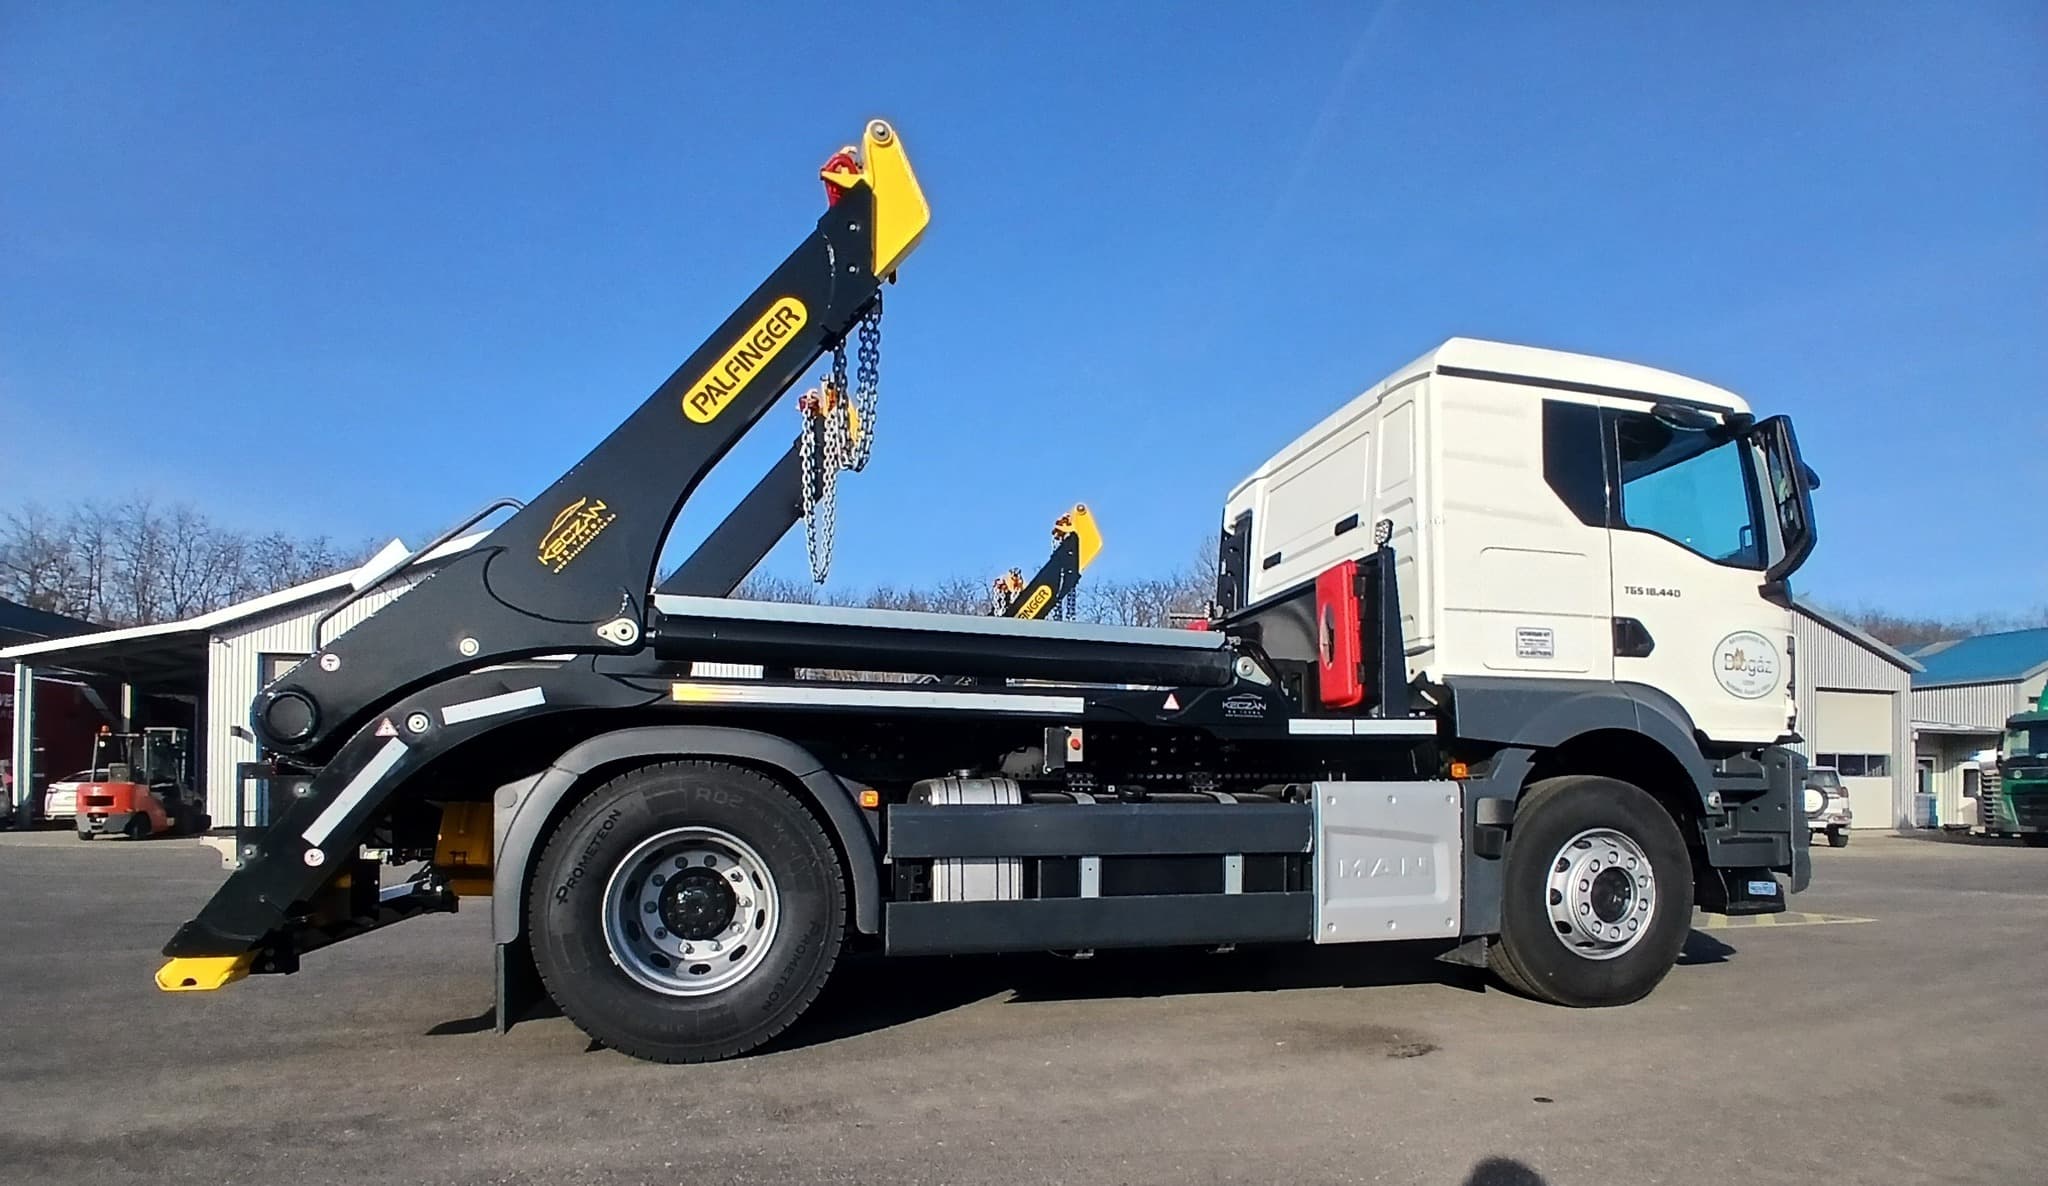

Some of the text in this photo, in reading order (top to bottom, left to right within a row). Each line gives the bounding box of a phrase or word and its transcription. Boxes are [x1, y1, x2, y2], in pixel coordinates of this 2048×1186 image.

[690, 305, 801, 416] PALFINGER
[1624, 586, 1681, 598] TGS 18.440
[554, 807, 623, 905] PROMETEON
[1338, 856, 1430, 879] MAN
